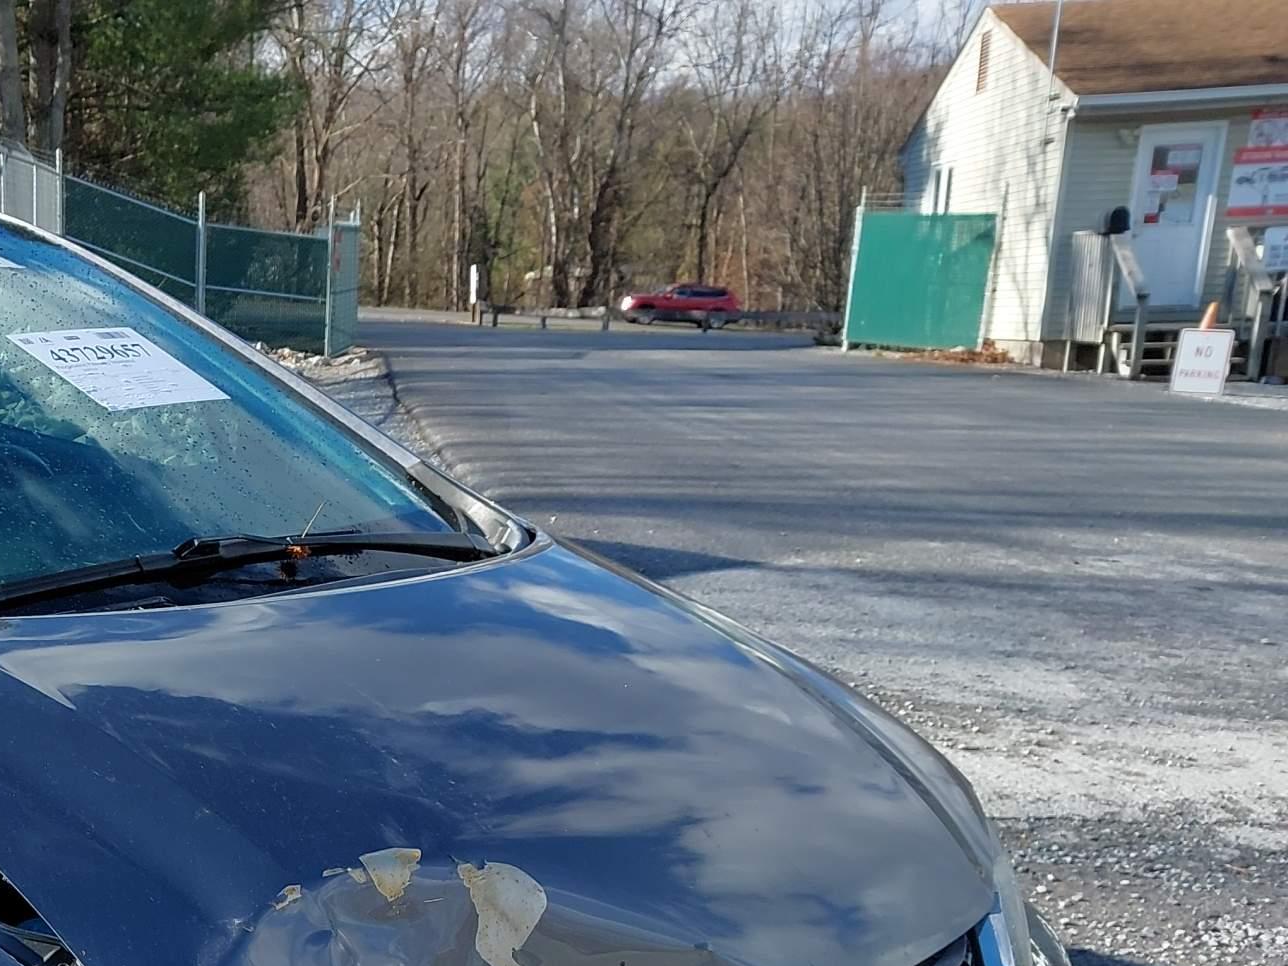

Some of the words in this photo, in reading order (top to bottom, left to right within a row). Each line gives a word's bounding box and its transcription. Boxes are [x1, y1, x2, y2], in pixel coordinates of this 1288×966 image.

[50, 343, 152, 363] 43729657
[1194, 345, 1213, 358] NO
[1178, 368, 1221, 379] PARKING
